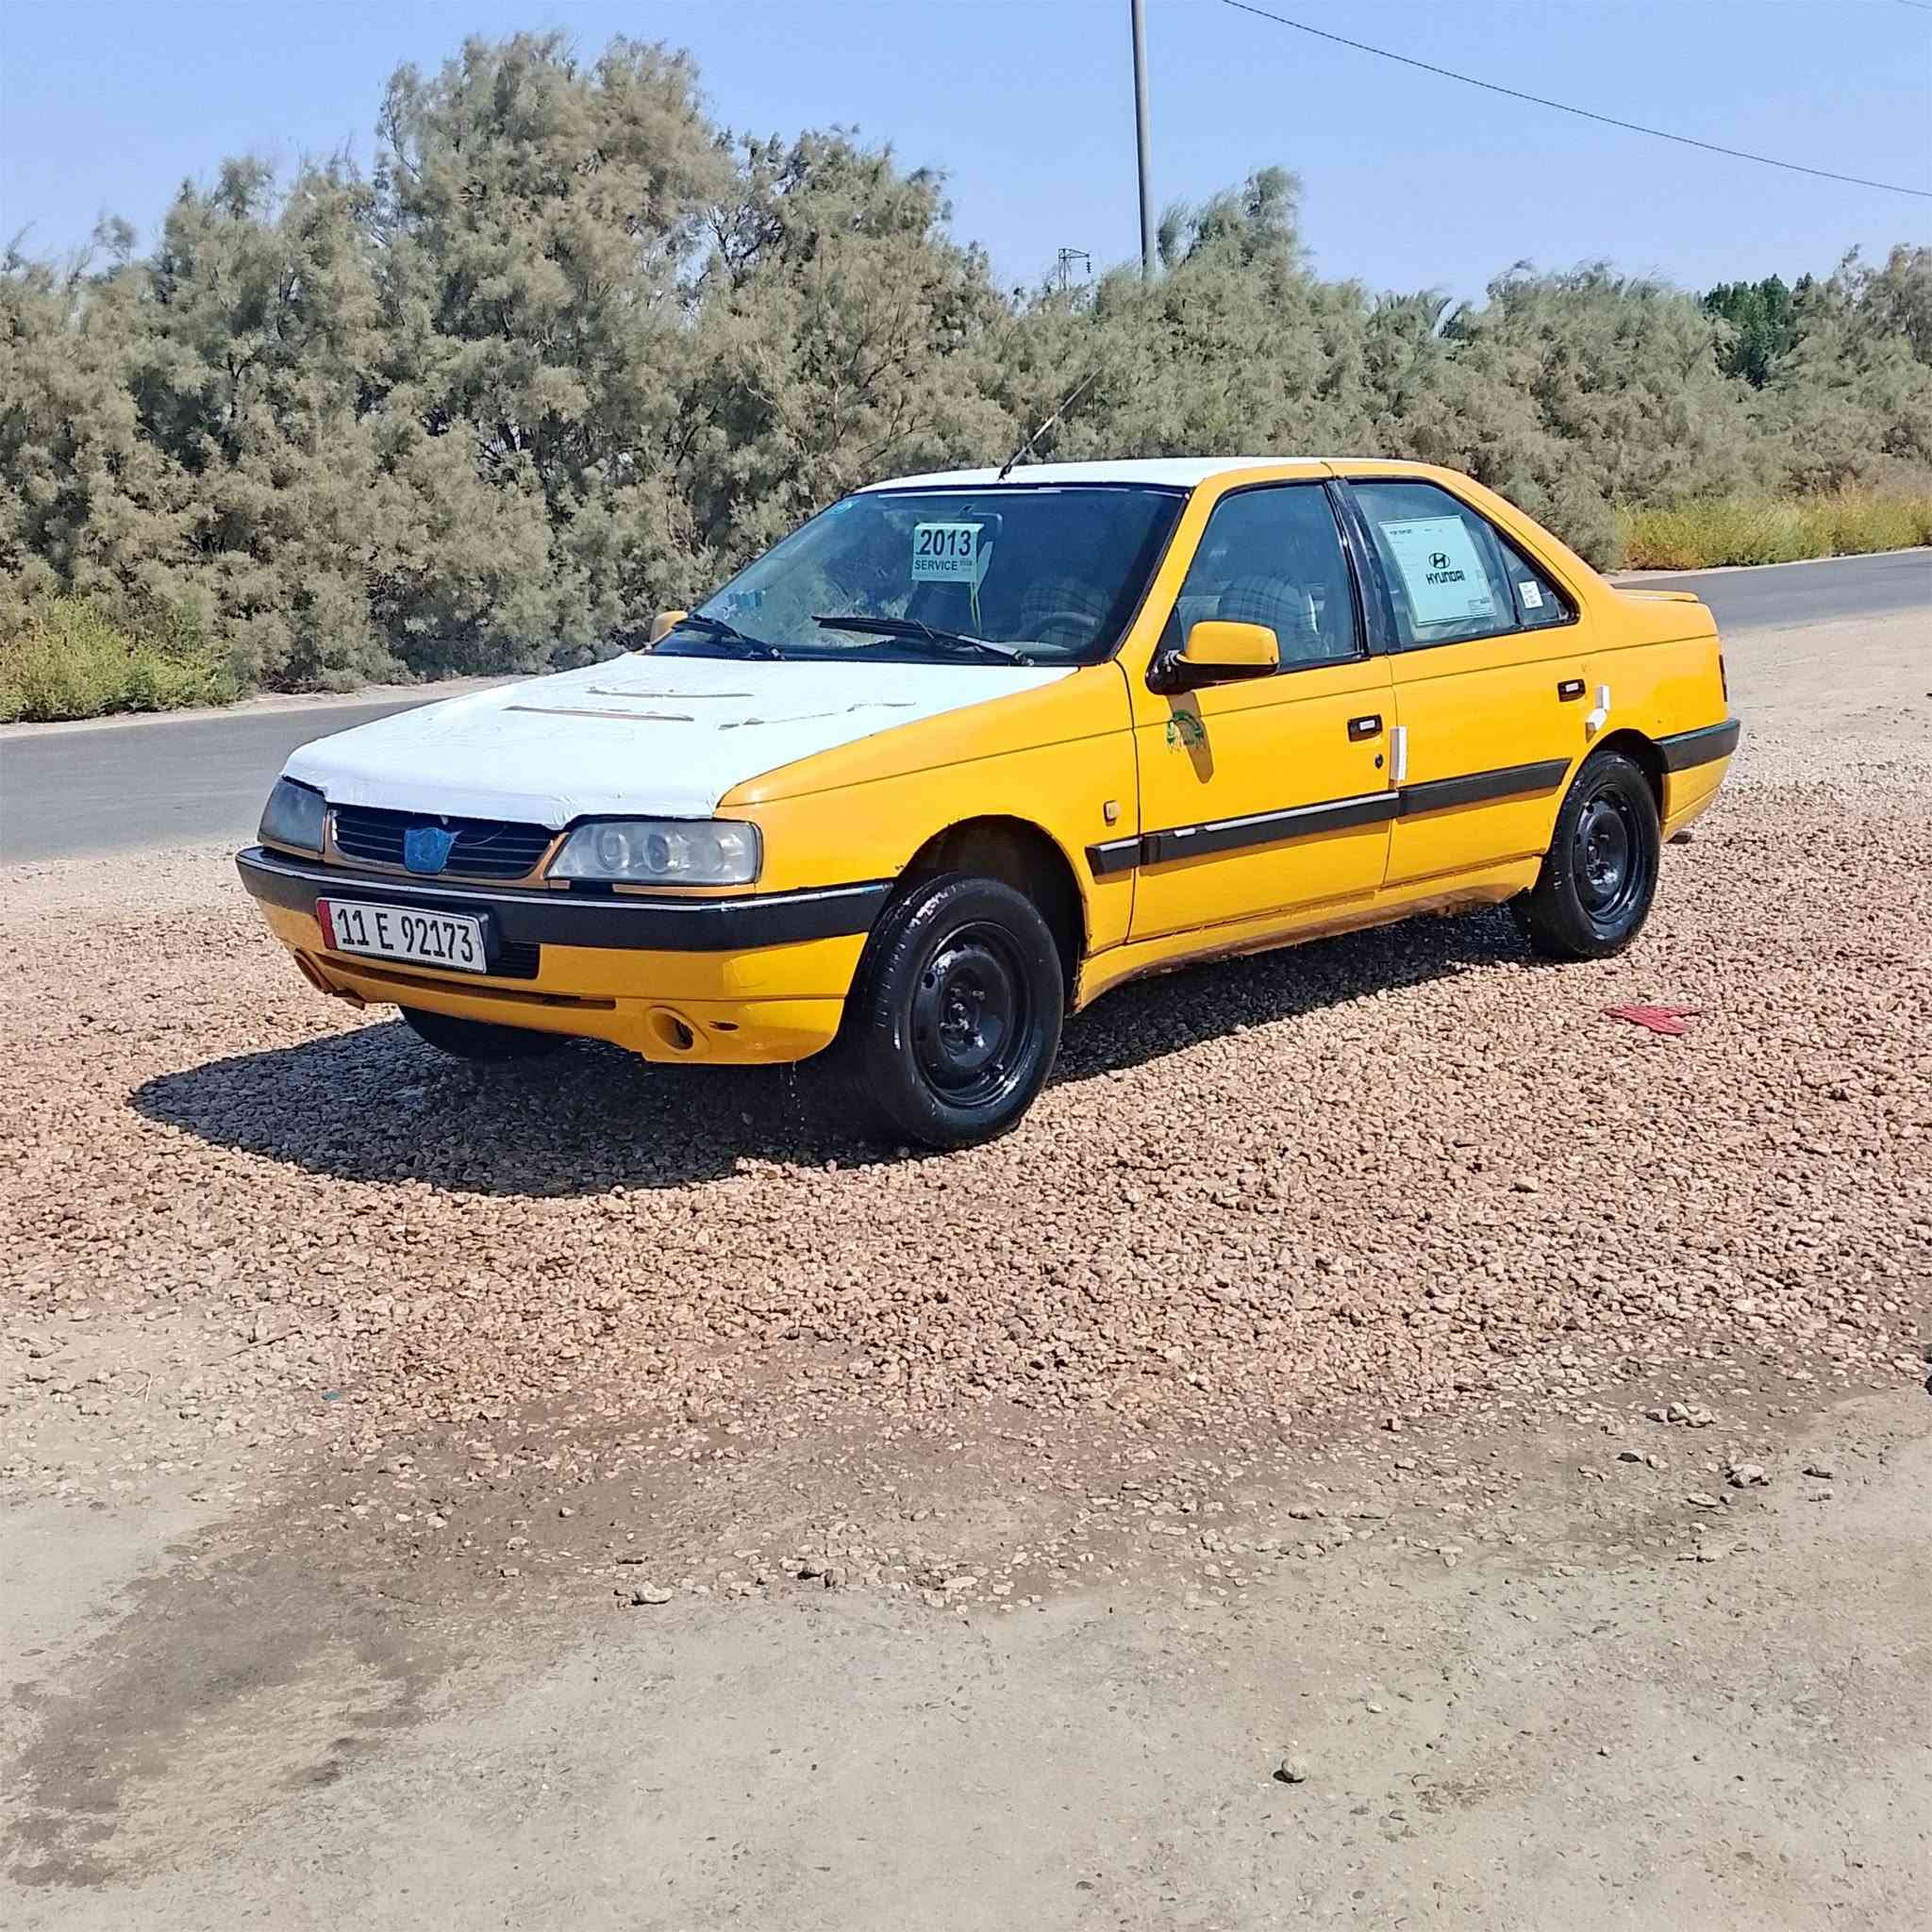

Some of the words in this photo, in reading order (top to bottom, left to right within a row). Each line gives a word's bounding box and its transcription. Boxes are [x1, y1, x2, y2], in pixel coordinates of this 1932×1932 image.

[915, 529, 972, 556] 2013
[914, 559, 959, 571] SERVICE
[1425, 570, 1465, 585] HYUNDAI
[337, 908, 370, 946] 11
[375, 912, 394, 950] E
[401, 916, 474, 963] 92173
